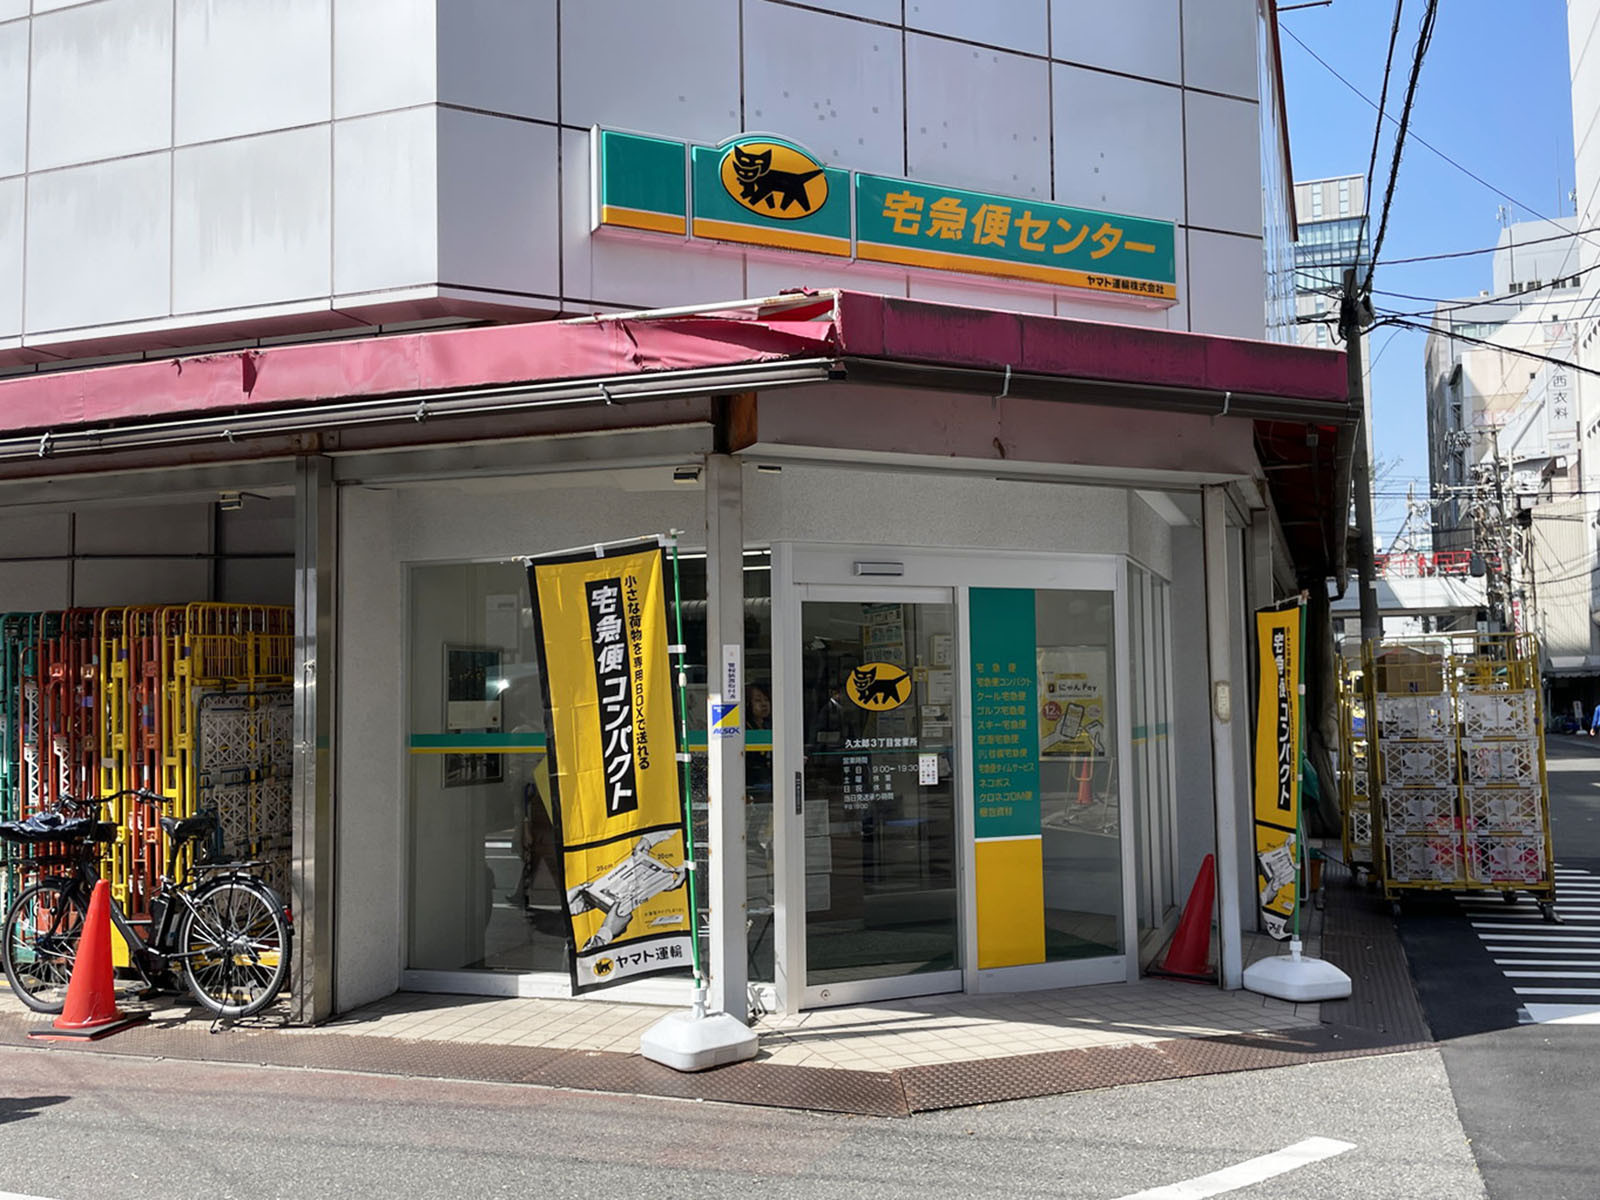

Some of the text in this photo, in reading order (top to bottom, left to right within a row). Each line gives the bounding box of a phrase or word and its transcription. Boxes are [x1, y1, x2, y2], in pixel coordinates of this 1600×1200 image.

[883, 191, 1156, 259] 宅急便センター
[1087, 275, 1164, 294] ヤマト運輸株式会社
[624, 575, 650, 770] 小さな荷物を専用BOXで送れる
[976, 663, 1016, 673] 宅急便
[976, 677, 1032, 688] 宅急便コンパクト
[591, 585, 633, 811] 宅急便コンパクト
[976, 691, 1026, 702] クール宅急便
[976, 705, 1025, 715] ゴルフ宅急便
[977, 719, 1027, 730] スキー宅急便
[845, 737, 918, 748] 久太郎3丁目営業所
[978, 763, 1034, 774] 宅急便タイムサービス
[979, 779, 1011, 788] ネコポス
[980, 791, 1033, 801] クロネコDM便
[615, 945, 683, 969] ヤマト運輸
